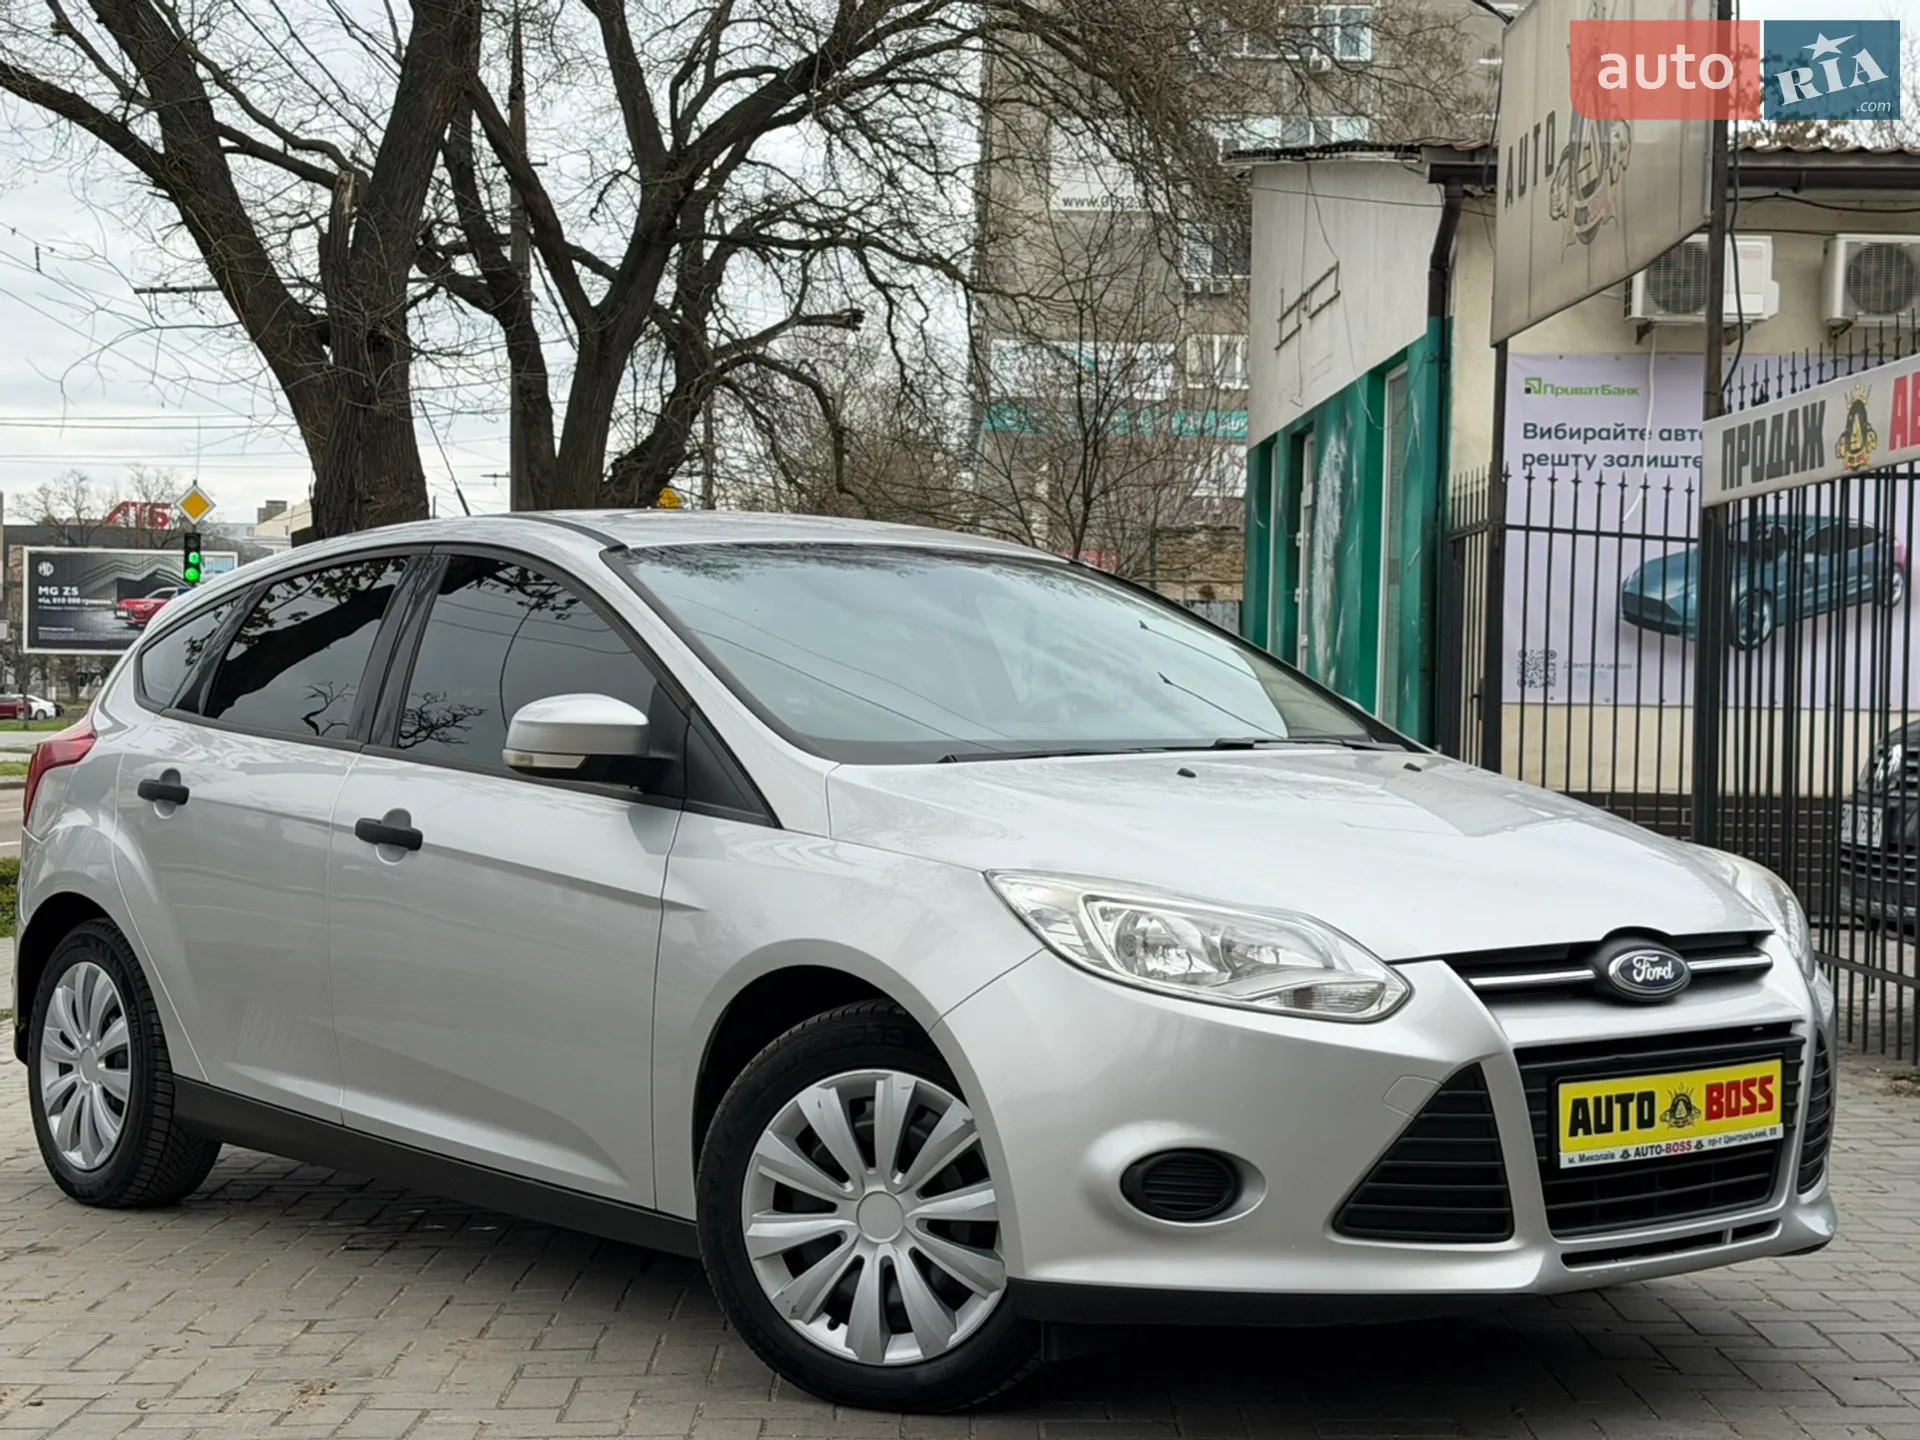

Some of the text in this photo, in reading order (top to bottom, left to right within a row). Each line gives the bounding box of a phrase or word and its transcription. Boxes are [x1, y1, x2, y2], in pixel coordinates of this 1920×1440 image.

[1505, 110, 1556, 209] AUTO
[1543, 383, 1641, 397] ПриватБанк
[1523, 422, 1652, 444] Вибирайте
[1721, 399, 1827, 492] ПРОДАЖ
[1522, 452, 1597, 471] решту
[38, 586, 79, 596] MG ZS
[1632, 956, 1675, 983] Ford
[1568, 1074, 1774, 1138] AUTO BOSS
[1634, 1140, 1692, 1158] AUTO-BOSS
